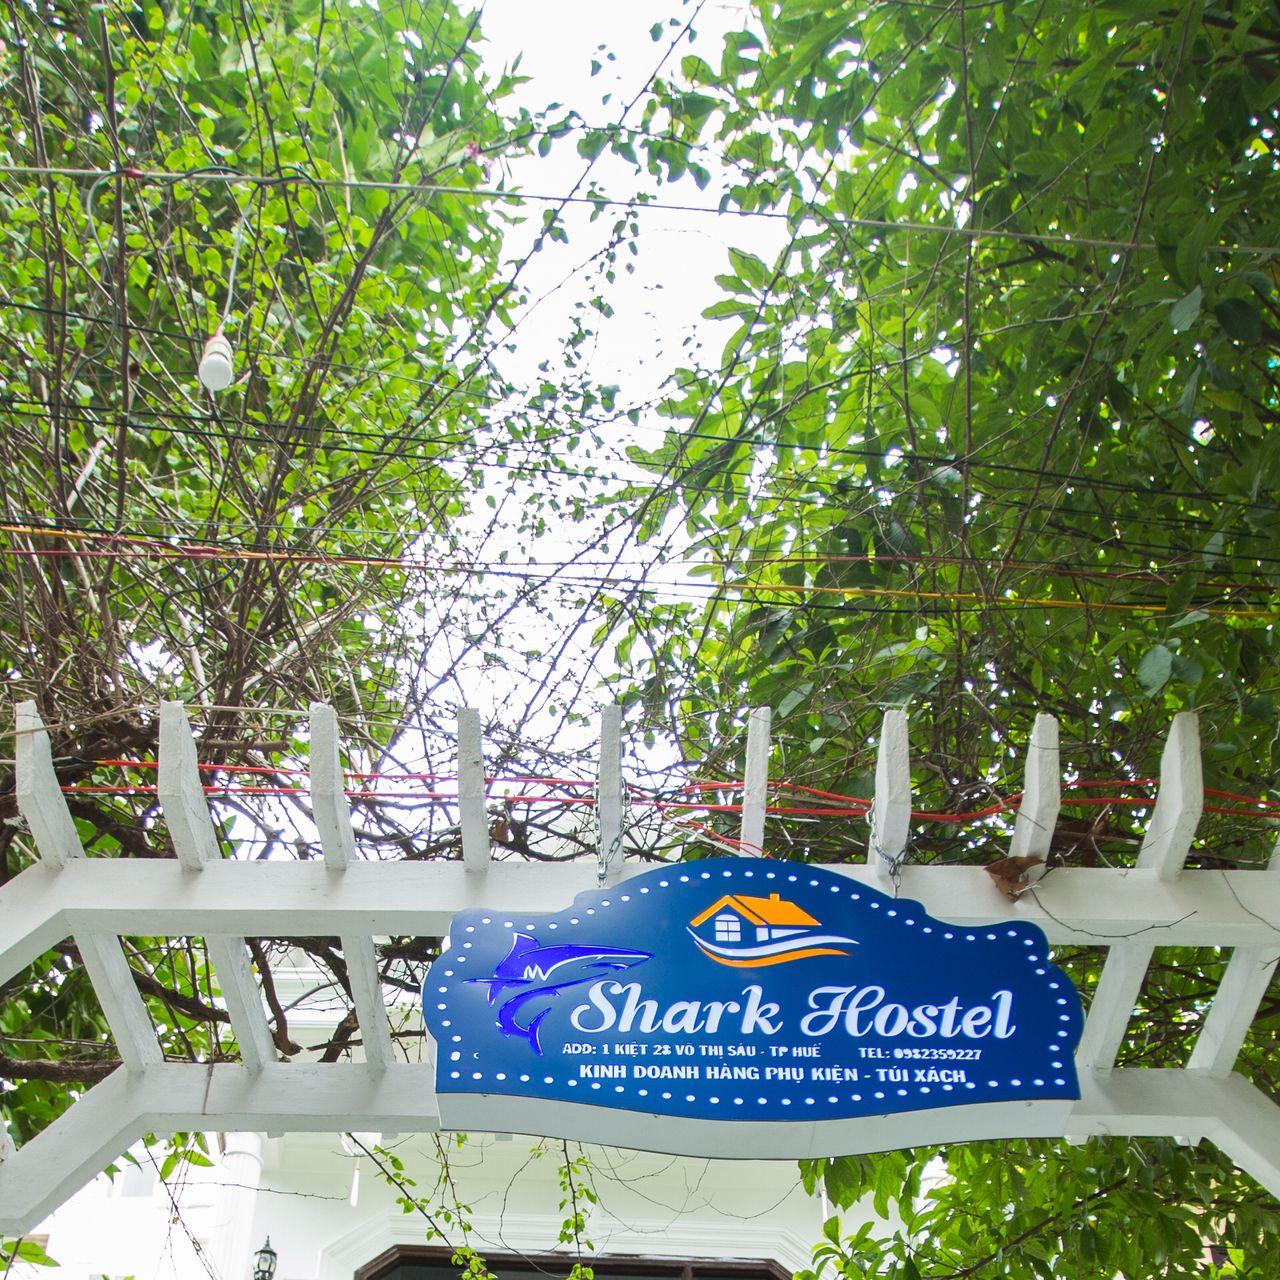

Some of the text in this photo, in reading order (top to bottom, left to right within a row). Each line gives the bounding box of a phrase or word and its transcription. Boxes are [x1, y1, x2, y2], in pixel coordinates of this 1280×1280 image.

[570, 980, 1017, 1039] Shark Hostel
[562, 1043, 597, 1054] ADD:
[602, 1044, 610, 1055] 1
[614, 1041, 648, 1058] KIỆT
[653, 1044, 671, 1055] 28
[676, 1042, 695, 1056] VÕ
[699, 1045, 723, 1059] THỊ
[728, 1043, 756, 1057] SÁU
[769, 1046, 789, 1058] TP
[793, 1043, 822, 1058] HUẾ
[858, 1048, 890, 1059] TEL:
[894, 1048, 982, 1060] 0982359227
[579, 1064, 627, 1078] KINH
[633, 1065, 700, 1079] DOANH
[706, 1063, 760, 1080] HÀNG
[765, 1067, 804, 1084] PHỤ
[811, 1065, 858, 1084] KIỆN
[876, 1066, 909, 1082] TÚI
[914, 1066, 967, 1083] XÁCH
